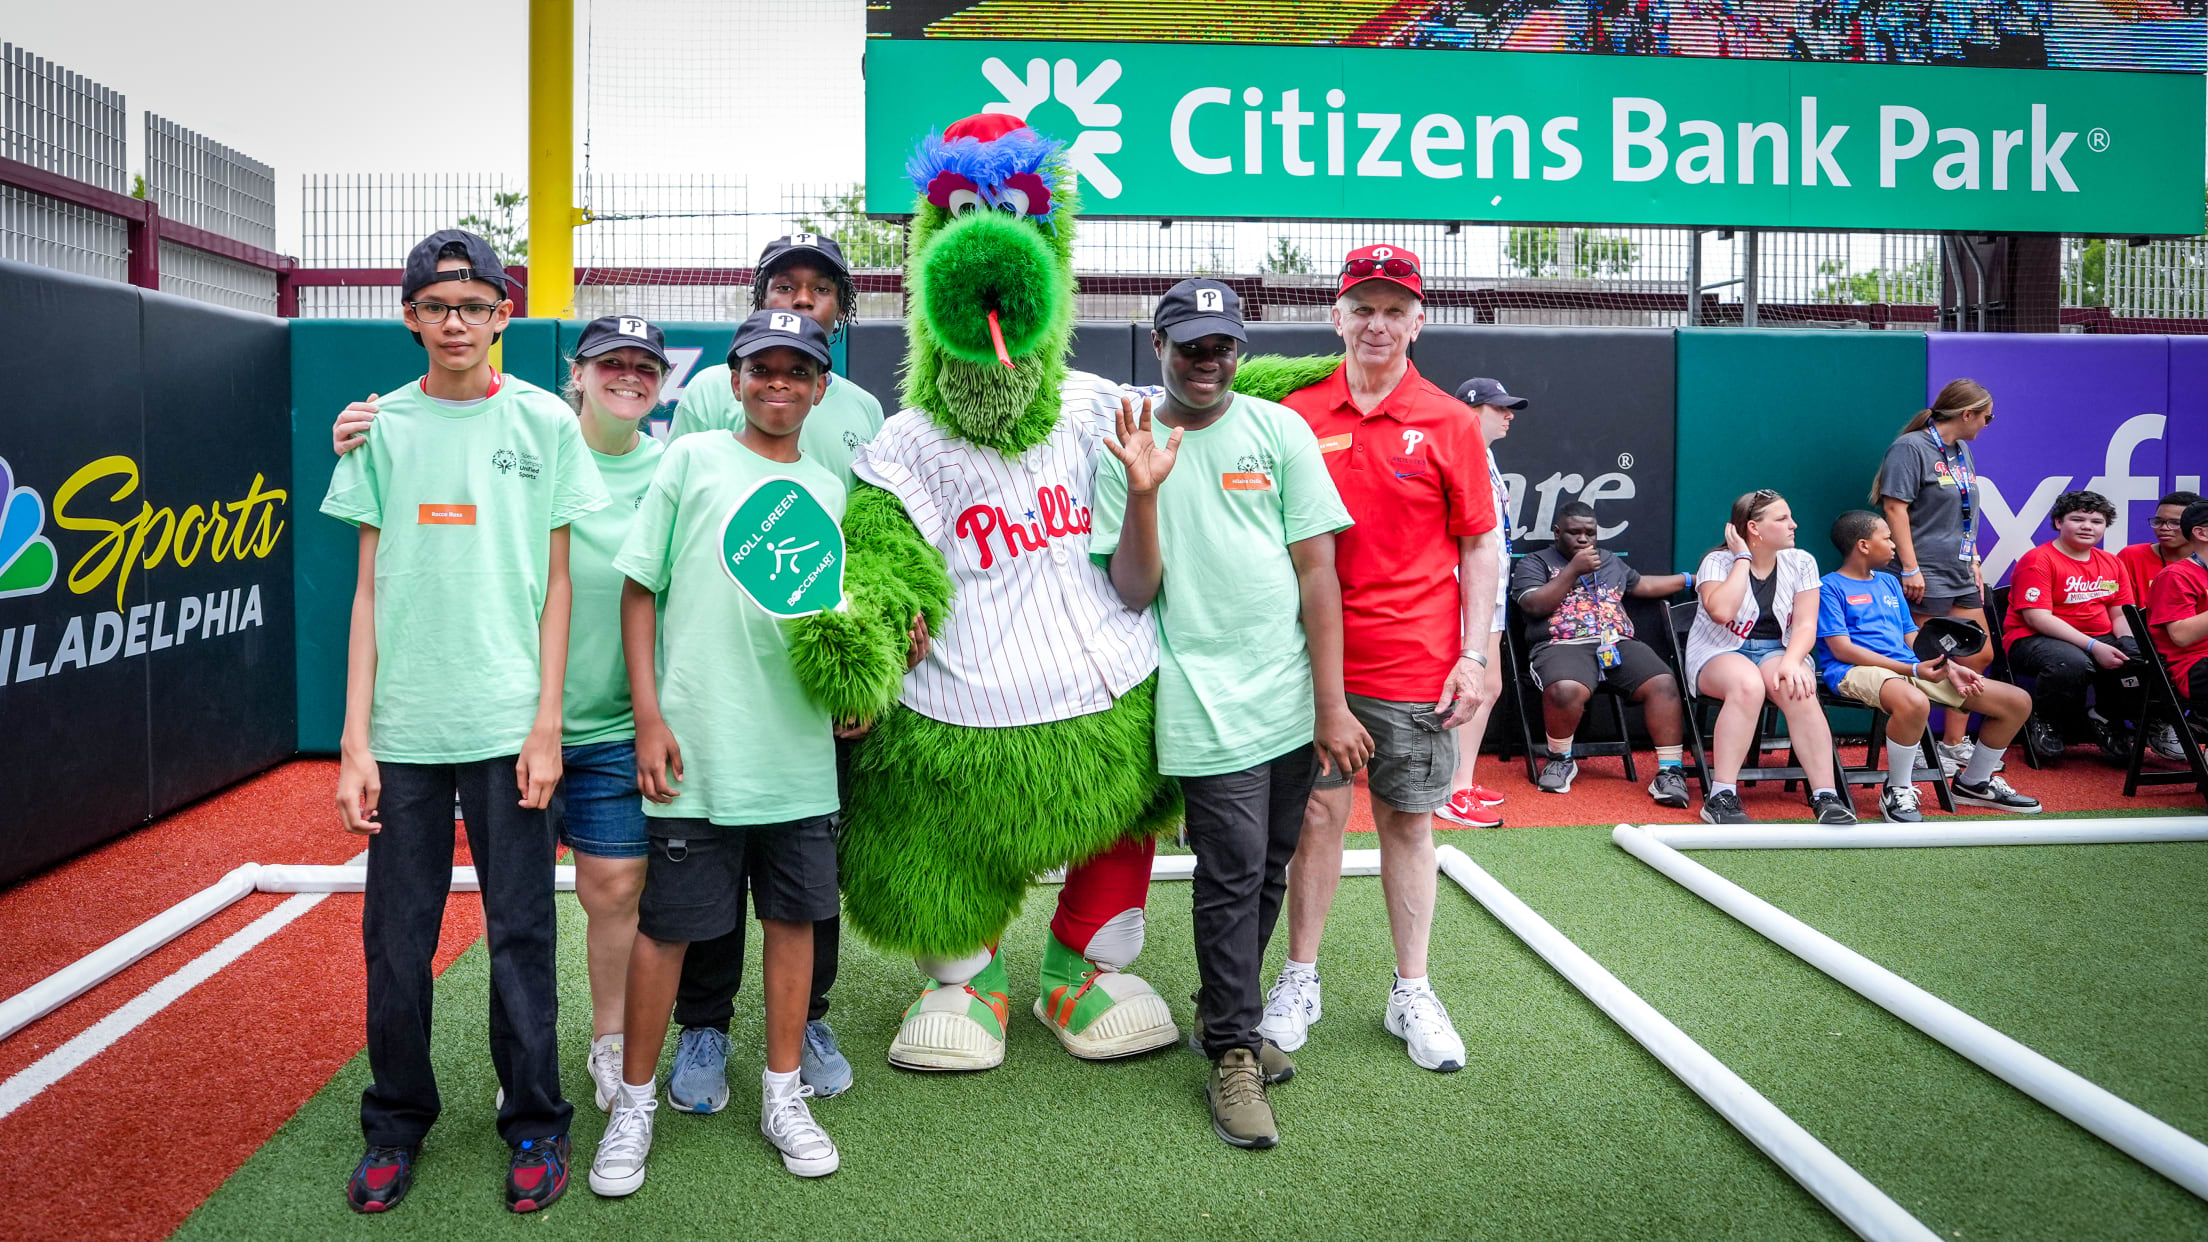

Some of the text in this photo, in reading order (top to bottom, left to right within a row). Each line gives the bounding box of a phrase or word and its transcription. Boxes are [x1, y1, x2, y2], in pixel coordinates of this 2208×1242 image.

[1170, 86, 1583, 182] Citizens
[1612, 96, 1852, 187] Bank
[626, 319, 642, 333] P
[777, 314, 794, 328] P
[1202, 291, 1217, 308] P
[1402, 429, 1425, 455] P
[52, 455, 287, 614] Sports
[731, 489, 799, 565] ROLL GREEN
[956, 484, 1094, 570] Phillie
[786, 550, 835, 607] BOCCEMART
